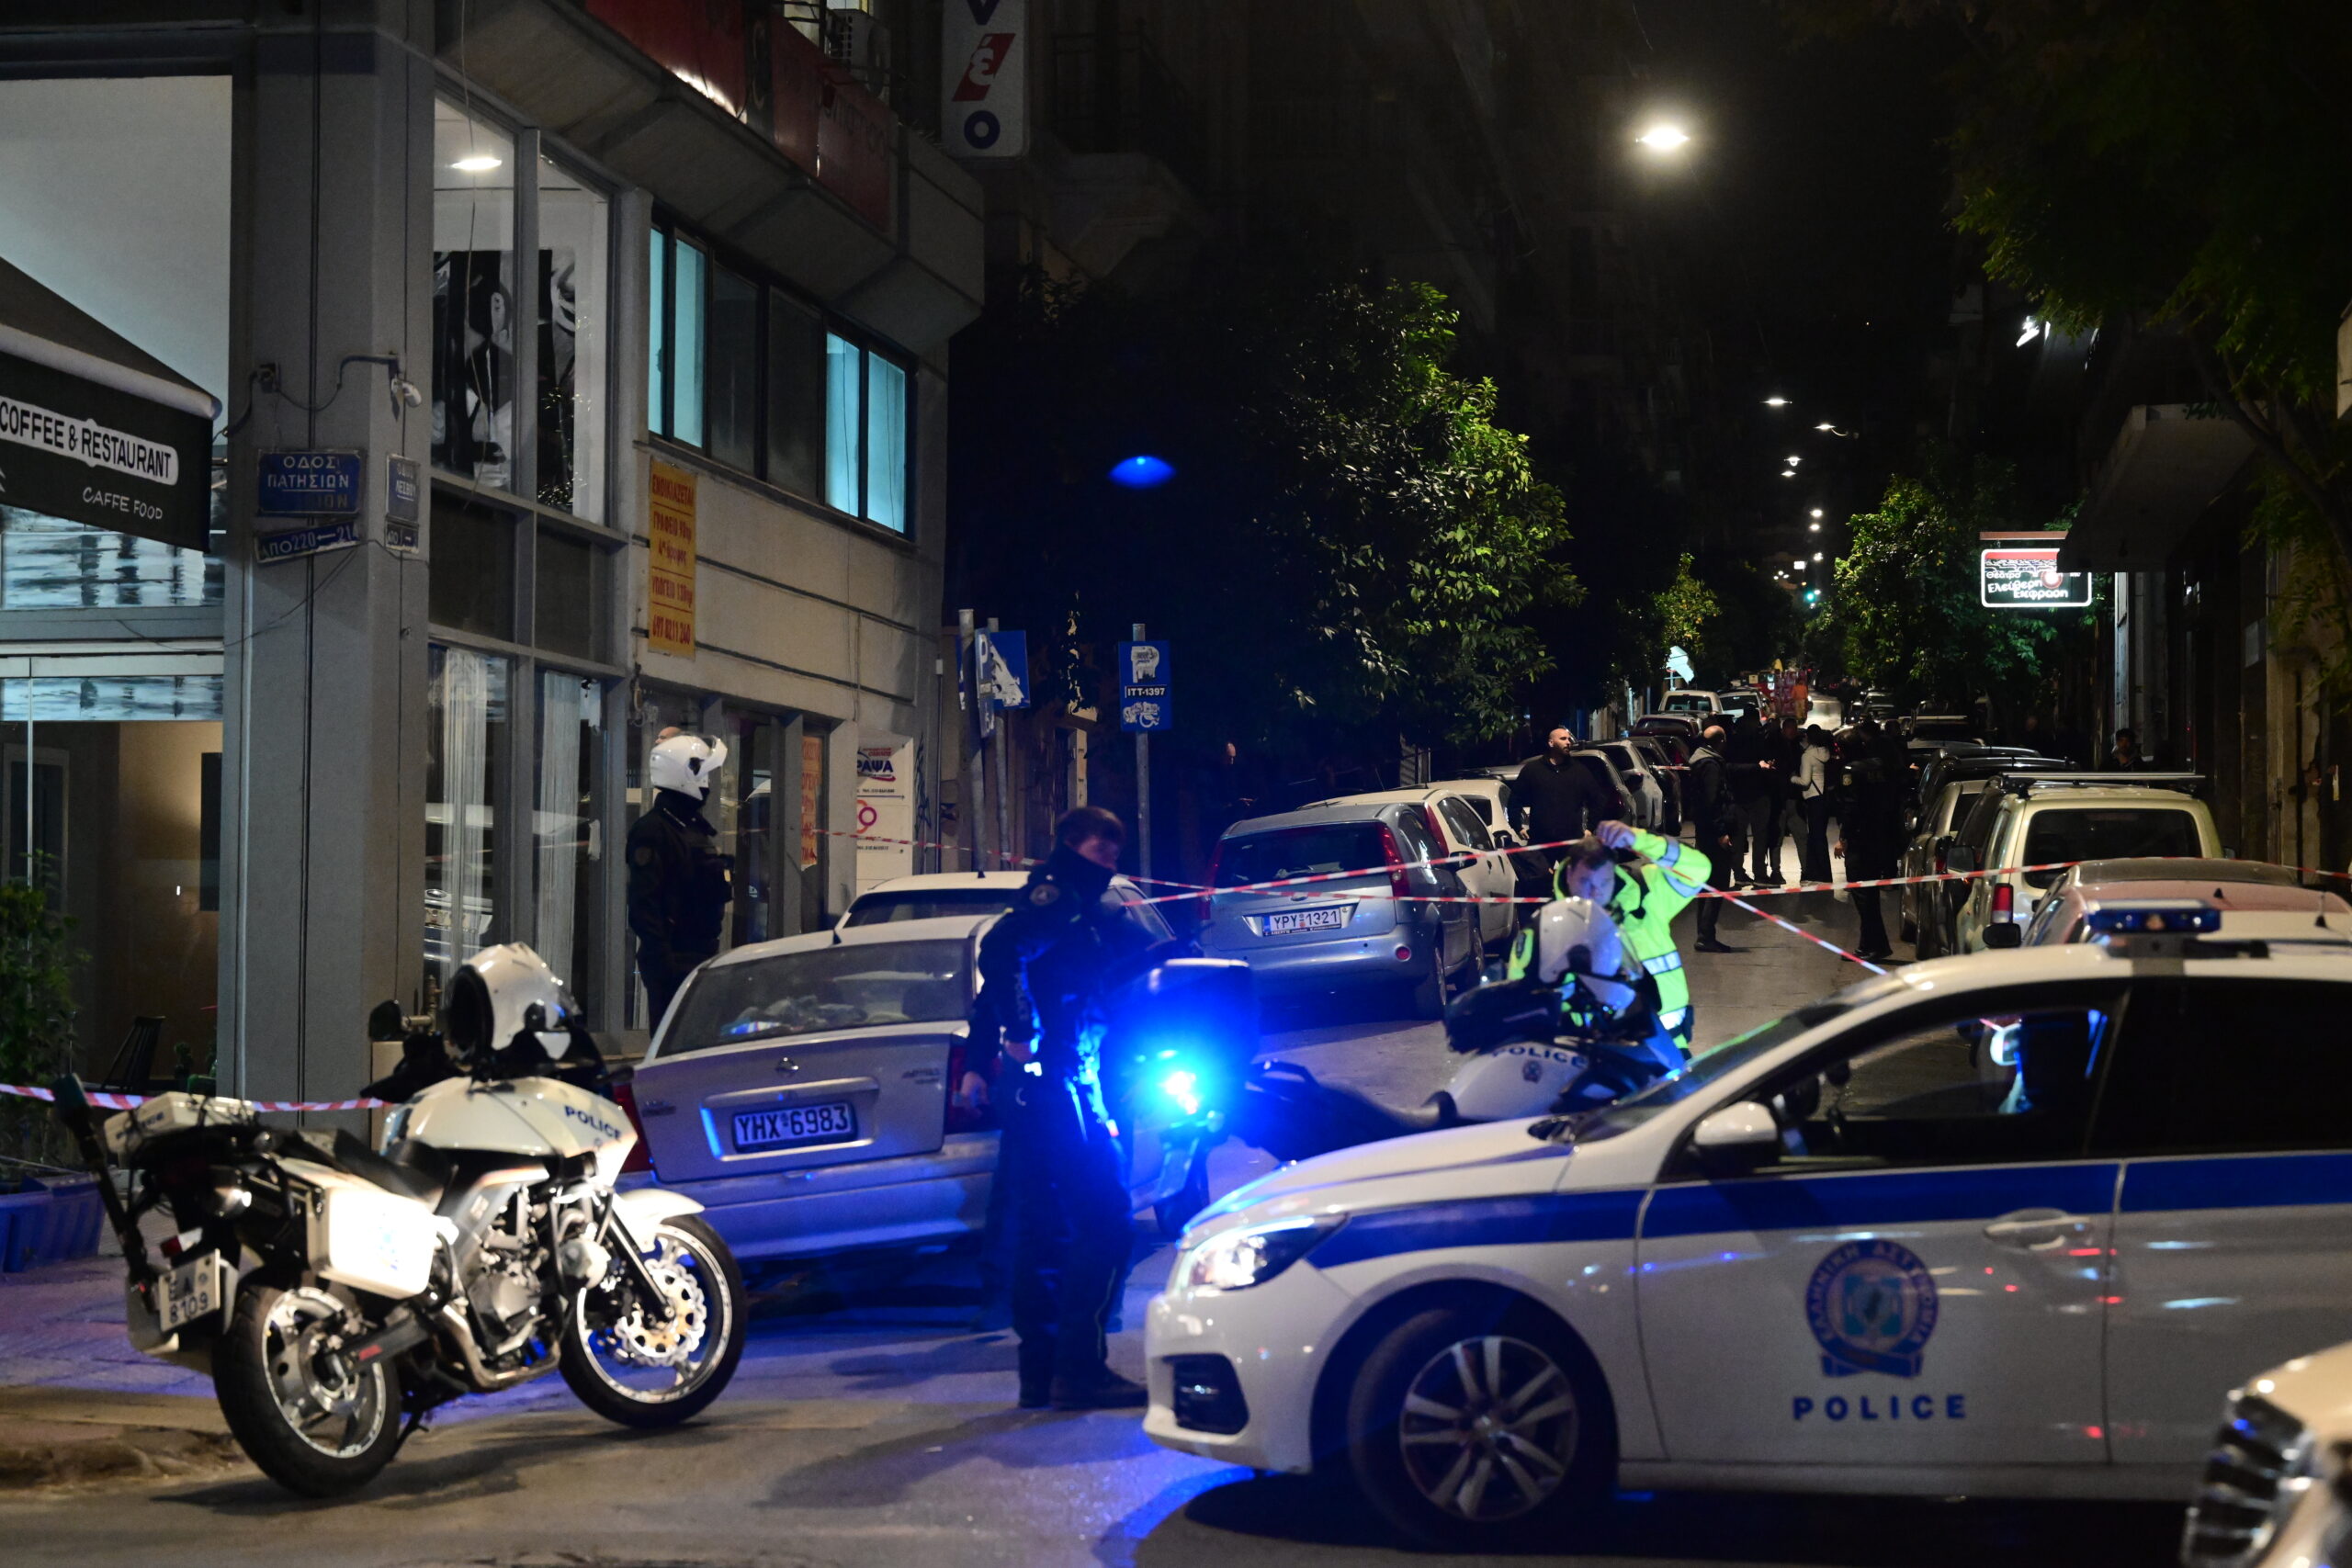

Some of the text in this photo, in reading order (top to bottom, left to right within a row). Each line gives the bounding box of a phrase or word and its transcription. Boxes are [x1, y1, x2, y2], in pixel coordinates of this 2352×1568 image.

[0, 400, 172, 479] COFFEE & RESTAURANT
[283, 456, 336, 468] ΟΔΟΣ
[267, 474, 349, 489] ΠΑΤΗΣΙΩΝ
[82, 486, 164, 521] CAFFE FOOD
[1126, 687, 1166, 697] ITT-1397
[564, 1105, 622, 1141] POLICE
[1792, 1394, 1966, 1421] POLICE
